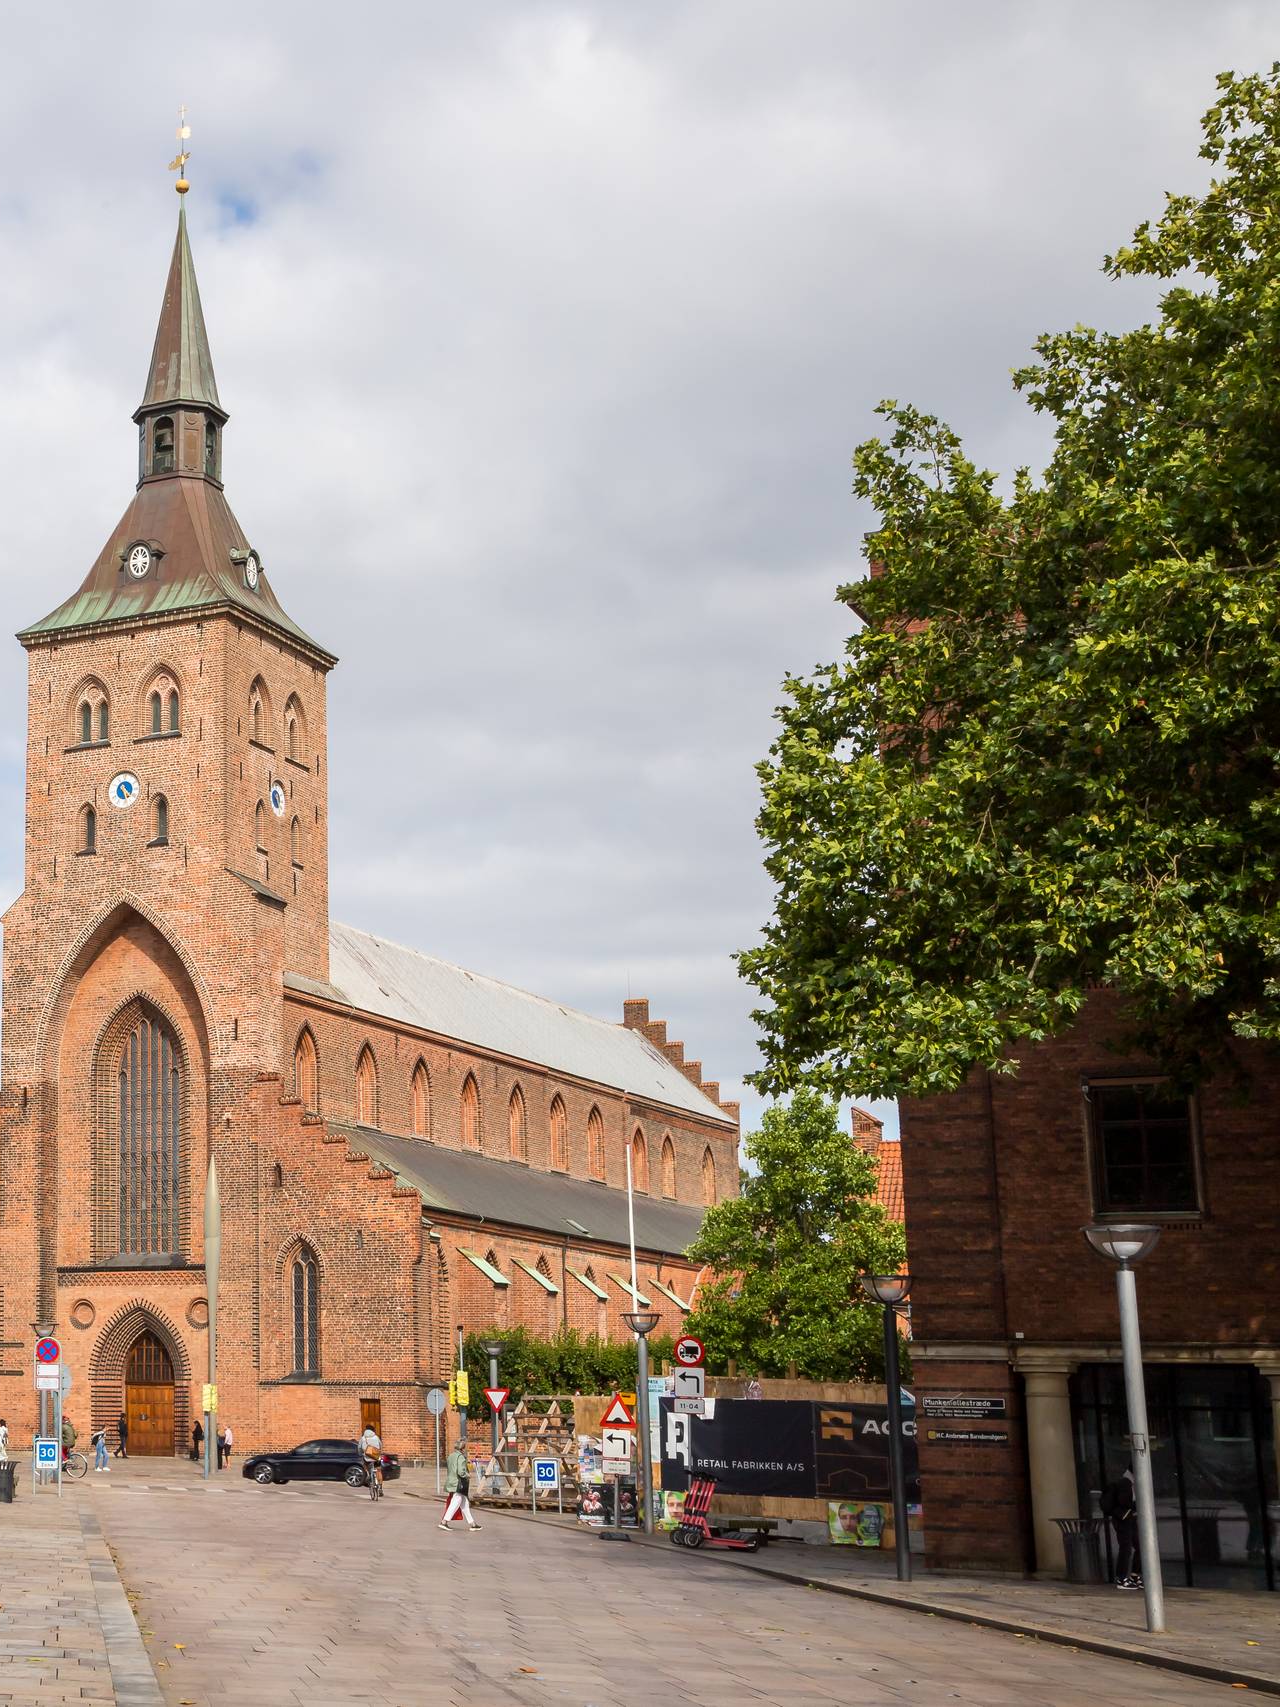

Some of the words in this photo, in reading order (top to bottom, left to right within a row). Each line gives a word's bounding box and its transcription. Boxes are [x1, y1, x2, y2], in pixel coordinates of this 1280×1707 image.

[680, 1402, 699, 1410] 11-04
[39, 1447, 55, 1457] 30
[697, 1459, 729, 1469] RETAIL
[731, 1460, 783, 1471] FABRIKKEN
[786, 1463, 805, 1472] A/S
[538, 1467, 554, 1478] 30
